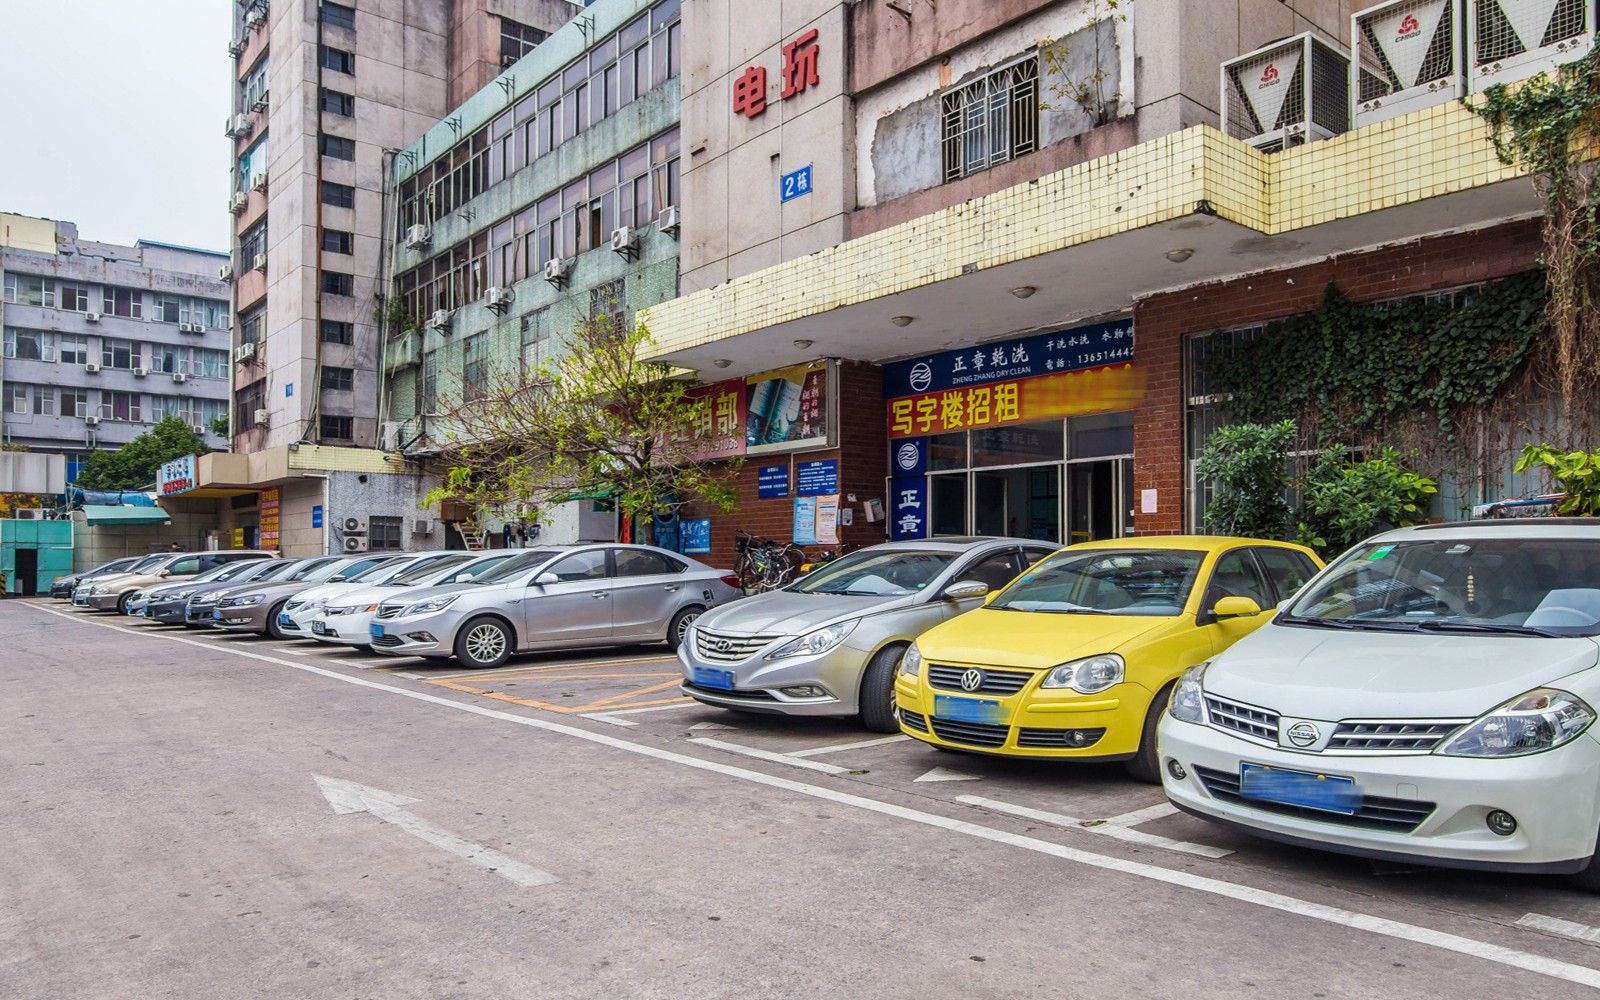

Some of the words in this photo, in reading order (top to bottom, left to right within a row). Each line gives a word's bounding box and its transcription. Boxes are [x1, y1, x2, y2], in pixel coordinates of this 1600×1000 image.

[733, 28, 820, 118] 电玩
[952, 343, 1029, 373] 正章乾洗
[1046, 334, 1090, 351] 干洗水洗
[952, 375, 972, 384] ZHENG
[973, 372, 995, 380] ZHANG
[996, 369, 1009, 377] DRY
[1009, 366, 1031, 375] CLEAN
[892, 383, 1020, 435] 写字楼招租
[898, 489, 922, 533] 正章
